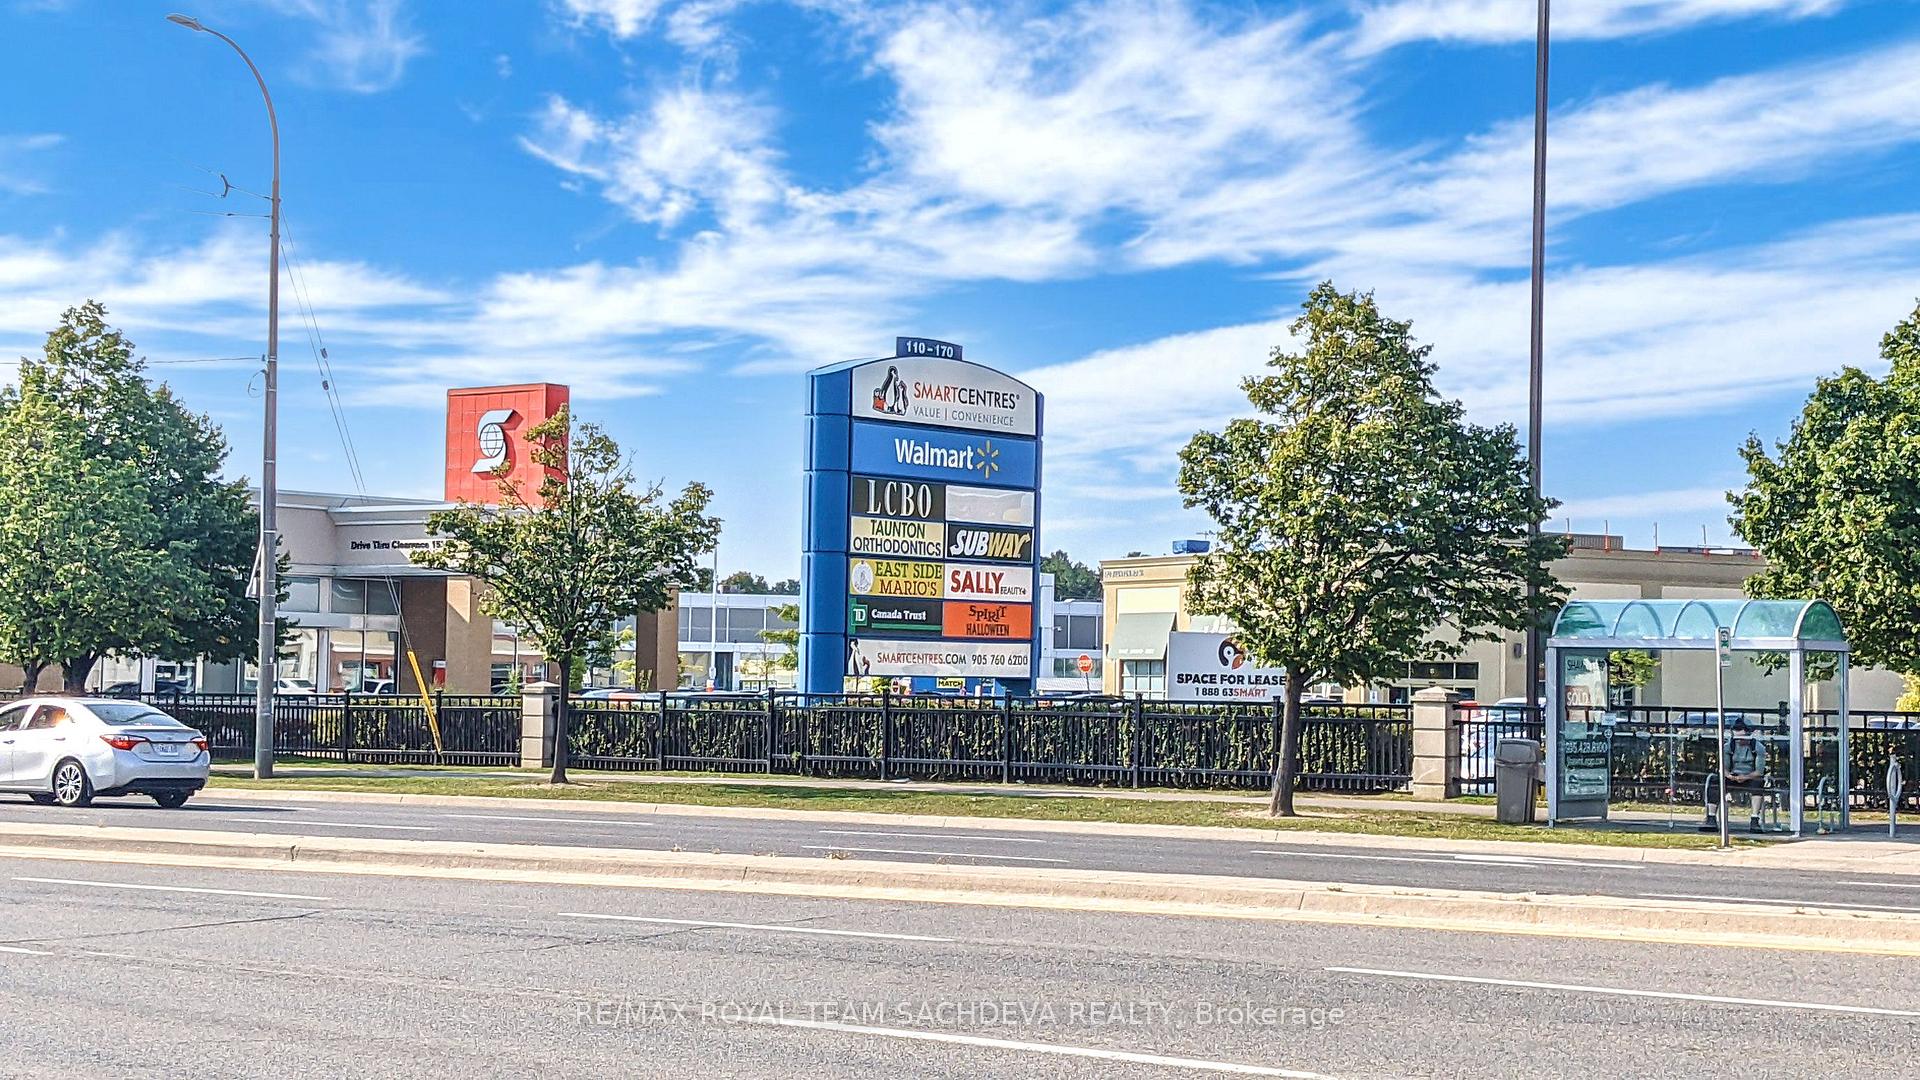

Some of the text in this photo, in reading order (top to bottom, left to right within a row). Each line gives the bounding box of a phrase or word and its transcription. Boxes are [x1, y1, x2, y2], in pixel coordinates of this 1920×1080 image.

[913, 382, 1016, 410] SMARTCENTRES
[913, 406, 1014, 427] VALUE CONVENIENCE
[894, 438, 974, 470] Walmart
[866, 479, 932, 519] LCBO
[870, 519, 926, 539] TAUNTON
[350, 541, 371, 550] Drive
[372, 541, 390, 549] Thru
[852, 536, 942, 557] ORTHODONTICS
[950, 529, 1031, 559] SUBWAY
[874, 561, 943, 580] EAST SIDE
[878, 578, 937, 597] MARIO'S
[950, 569, 1005, 595] SALLY
[852, 608, 927, 622] TD Canada Trust
[966, 622, 1010, 637] HALLOWEEN
[876, 652, 967, 666] SMARTCENTRES.COM
[971, 654, 988, 666] 905
[990, 654, 1006, 666] 760
[1176, 673, 1287, 687] SPACE FOR LEASE
[1200, 687, 1220, 697] 888
[1222, 688, 1268, 698] 63SMART
[1566, 691, 1589, 706] SOLD
